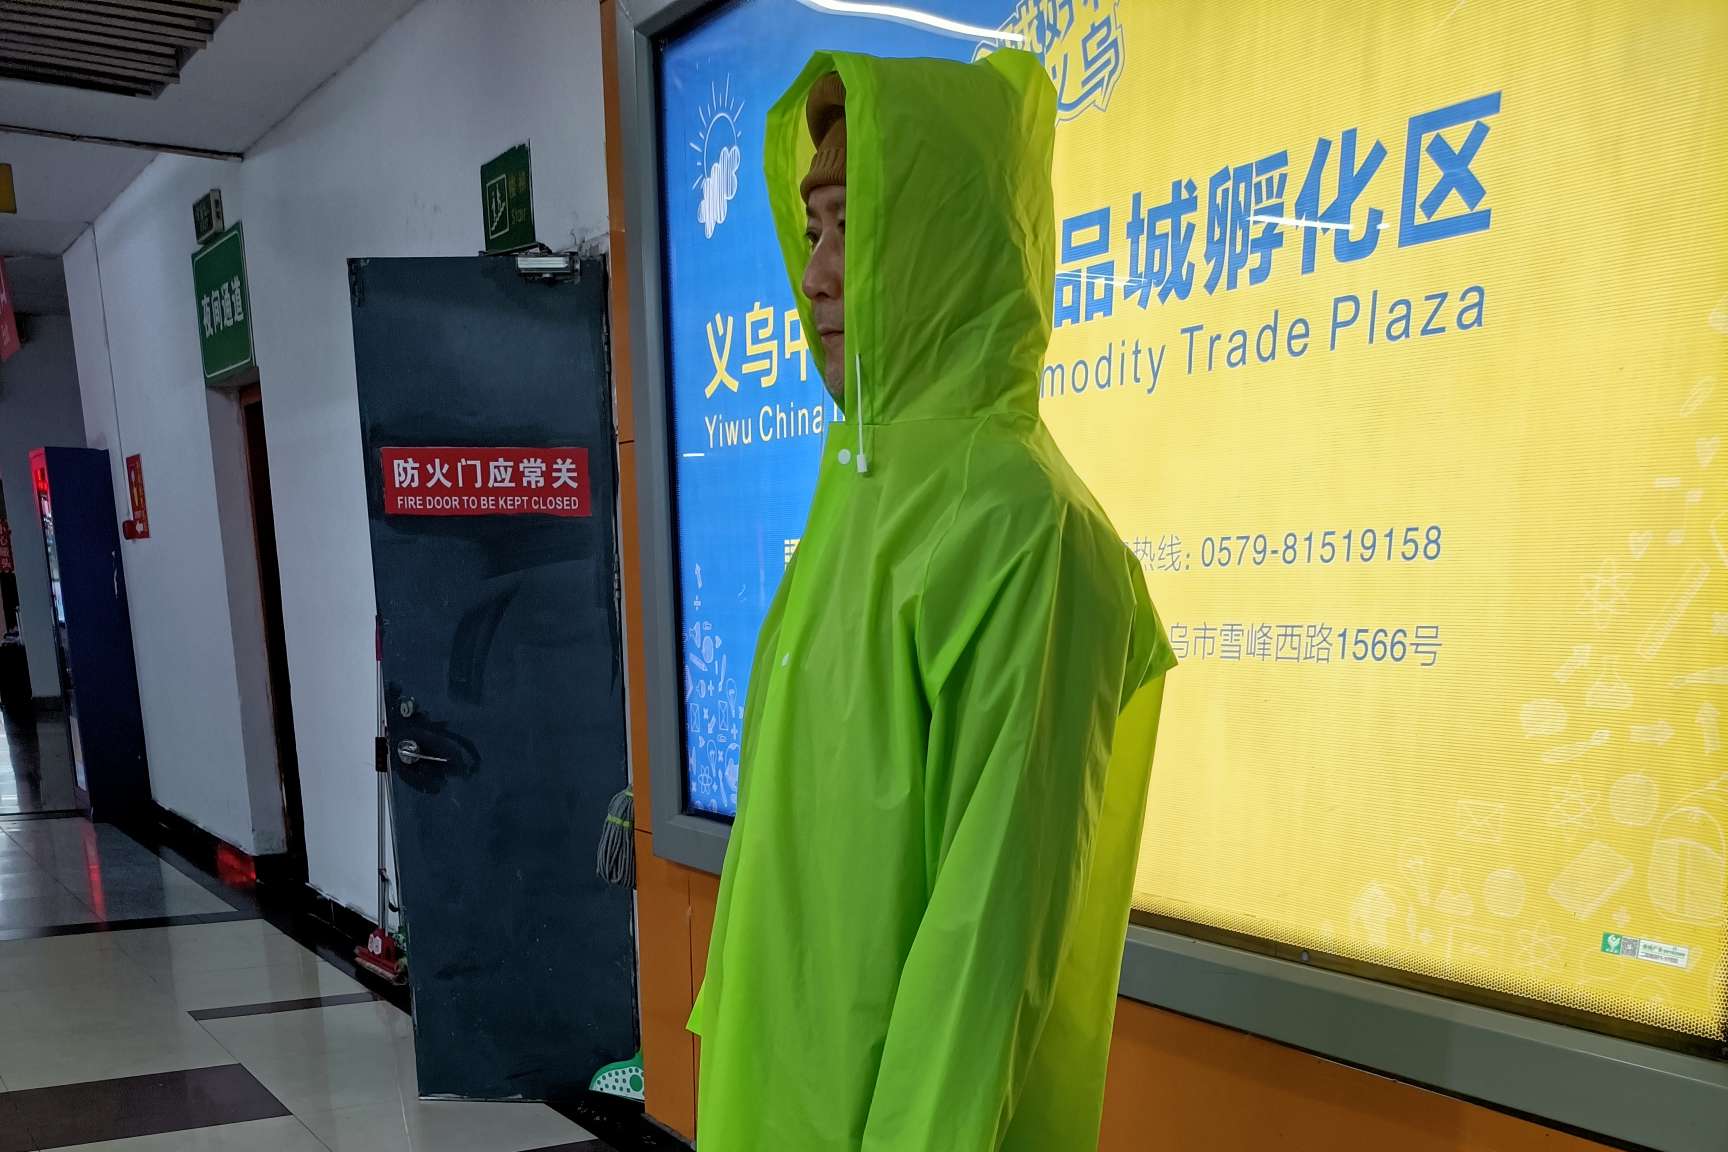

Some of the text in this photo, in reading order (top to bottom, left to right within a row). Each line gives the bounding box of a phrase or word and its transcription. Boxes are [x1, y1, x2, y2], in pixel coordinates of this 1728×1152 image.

[1054, 90, 1503, 329] 品城孵化区
[704, 301, 809, 399] 义乌中
[1040, 283, 1487, 399] modity Trade Plaza
[704, 413, 752, 449] Yiwu
[759, 401, 824, 442] China
[393, 457, 579, 489] 防火门应常关
[397, 496, 579, 510] FIRE DOOR TO BE KEPT CLOSED
[1124, 524, 1443, 572] 热线: 0579-81519158
[1169, 620, 1443, 667] 乌市雪峰西路1566号
